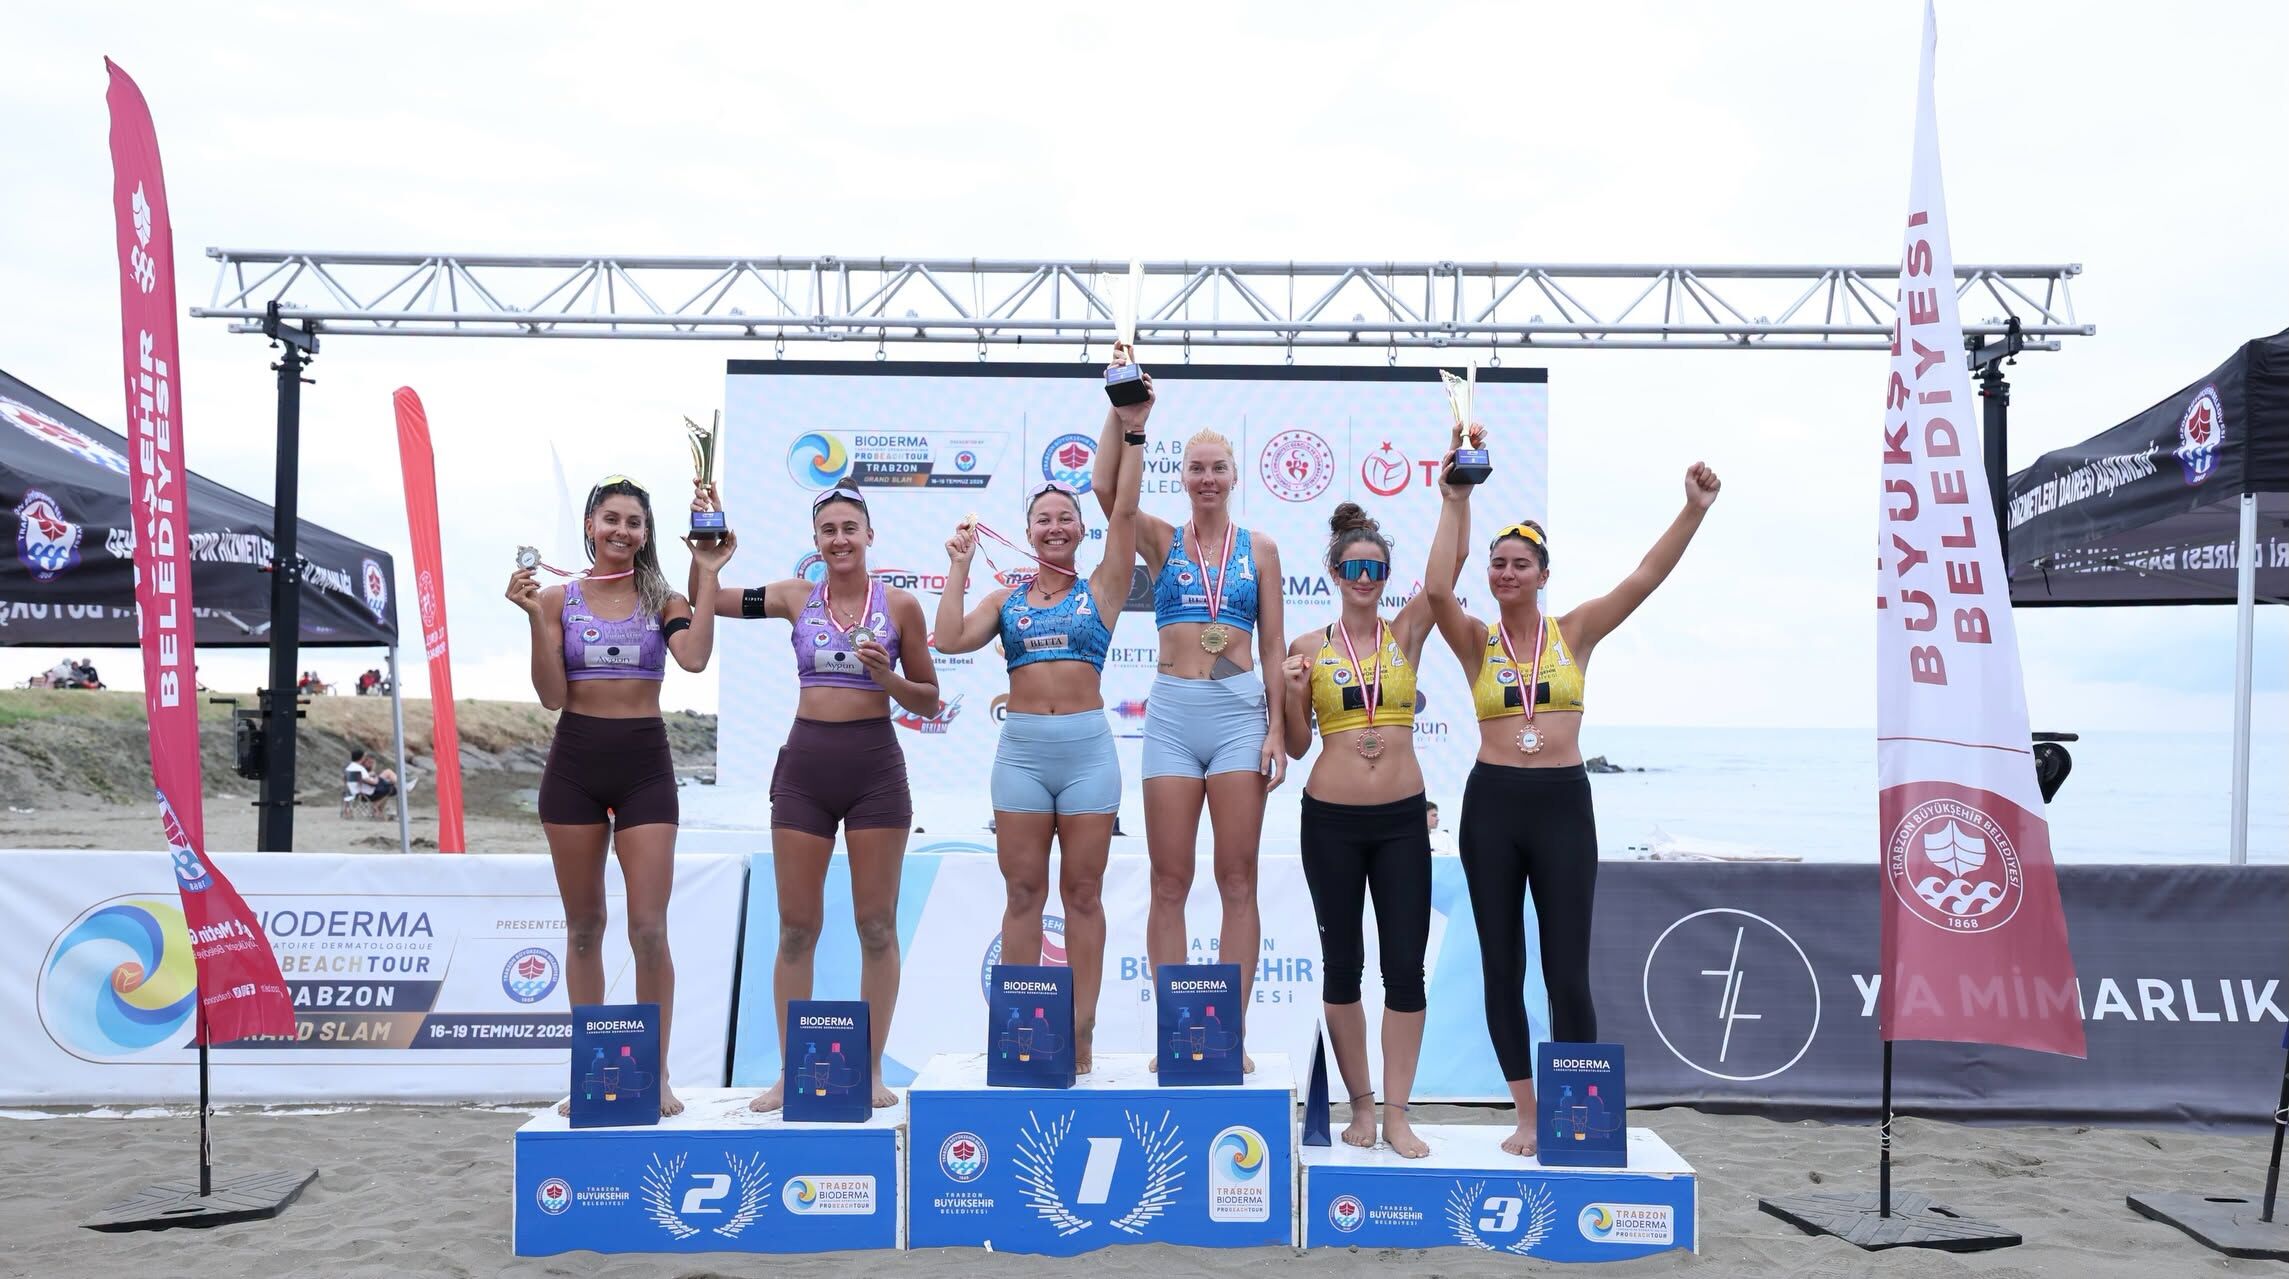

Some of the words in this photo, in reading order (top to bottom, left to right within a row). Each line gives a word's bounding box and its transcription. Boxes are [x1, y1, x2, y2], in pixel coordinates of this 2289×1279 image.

[1907, 210, 1992, 644] BELEDİYESİ
[854, 435, 929, 447] BIODERMA
[866, 463, 918, 473] TRABZON
[155, 358, 179, 708] BELEDİYESİ
[1075, 592, 1091, 615] 2
[871, 612, 886, 633] 2
[1030, 637, 1062, 648] BETTA
[1111, 648, 1158, 662] BETT
[1388, 640, 1404, 667] 2
[1553, 640, 1571, 666] 1
[949, 657, 974, 665] Hotel
[1894, 821, 1916, 878] TRABZON
[1913, 802, 1983, 825] BÜYÜKŞEHİR
[1983, 820, 2021, 889] BELEDİYESİ
[253, 911, 434, 937] IODERMA
[496, 920, 567, 930] PRESENTED
[1948, 918, 1979, 928] 1868
[273, 942, 316, 950] ATOIRE
[321, 942, 433, 950] DERMATOLOGIQUE
[282, 956, 431, 973] BEACHTOUR
[1003, 981, 1058, 992] BIODERMA
[1171, 980, 1227, 990] BIODERMA
[289, 986, 394, 1006] ABZON
[586, 1020, 644, 1032] BIODERMA
[800, 1016, 854, 1027] BIODERMA
[320, 1021, 392, 1041] SLAM
[430, 1024, 468, 1038] 16-19
[471, 1024, 534, 1038] TEMMUZ
[536, 1024, 573, 1038] 2026
[1553, 1058, 1611, 1069] BIODERMA
[1077, 1137, 1122, 1204] 1
[820, 1182, 869, 1190] TRABZON
[1216, 1187, 1262, 1195] TRABZON
[681, 1174, 732, 1214] 2
[819, 1191, 869, 1199] BIODERMA
[1216, 1196, 1263, 1204] BIODERMA
[1478, 1196, 1523, 1232] 3
[1616, 1209, 1667, 1220] TRABZON
[1616, 1219, 1667, 1229] BIODERMA
